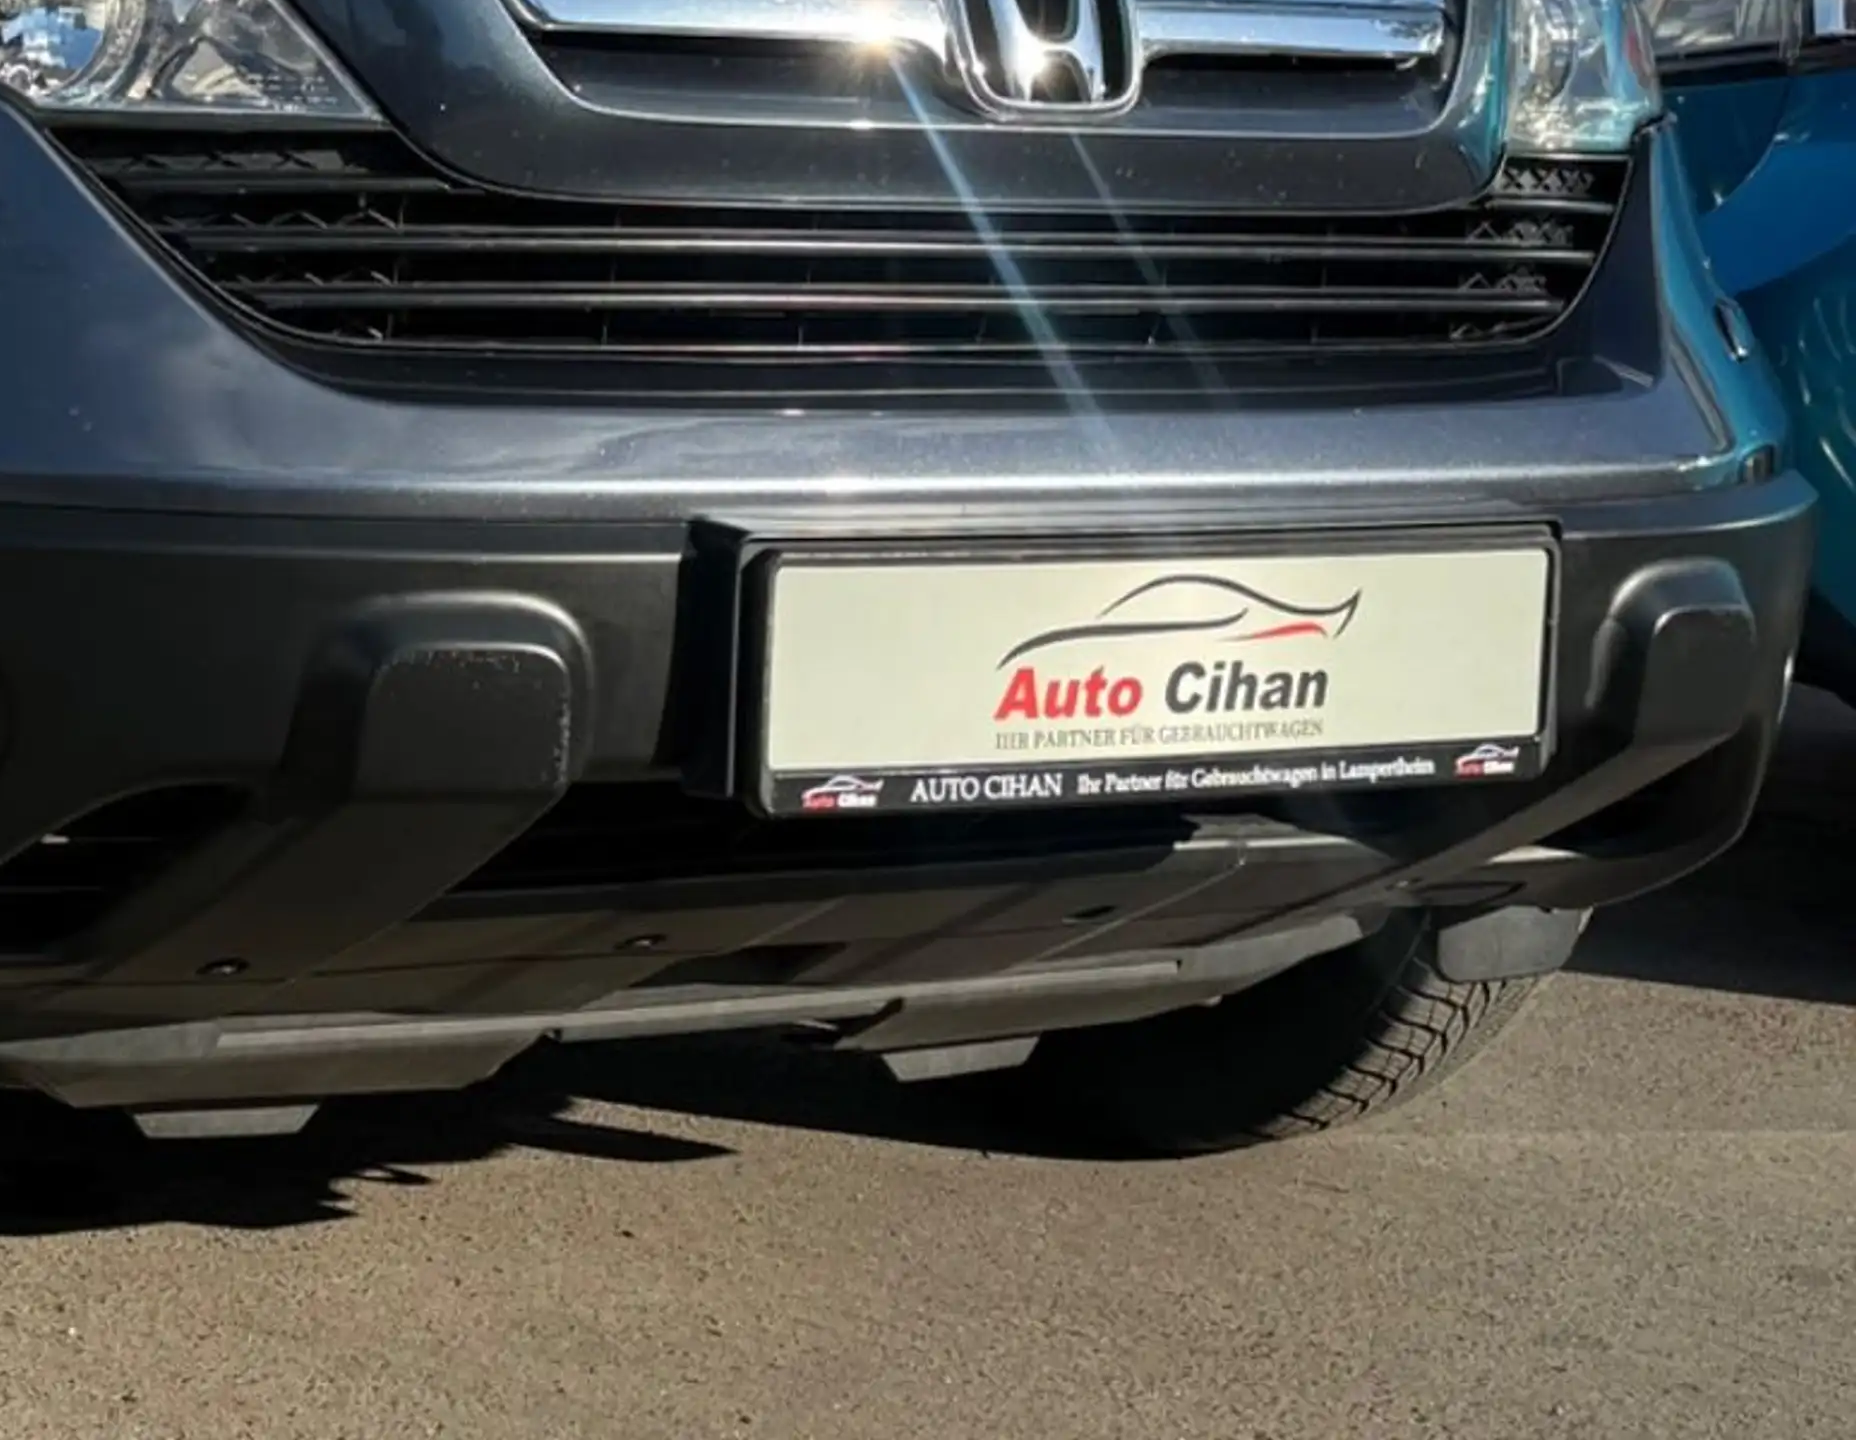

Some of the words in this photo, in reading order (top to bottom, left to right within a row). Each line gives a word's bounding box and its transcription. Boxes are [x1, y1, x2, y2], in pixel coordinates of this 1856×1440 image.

[993, 665, 1143, 721] Auto
[1165, 661, 1330, 714] Cihan
[995, 730, 1030, 751] IHR
[1033, 727, 1117, 749] PARTNER
[1119, 722, 1156, 746] FÜR
[1160, 718, 1324, 744] GEBRAUCHTWAGEN
[910, 774, 980, 803] AUTO
[983, 772, 1064, 800] CIHAN
[1076, 774, 1102, 795] Ihr
[1104, 770, 1163, 793] Partner
[1165, 768, 1190, 791] für
[1191, 763, 1318, 789] Gebrauchtwagen
[1320, 759, 1337, 781] in
[1339, 756, 1437, 784] Lampertheim
